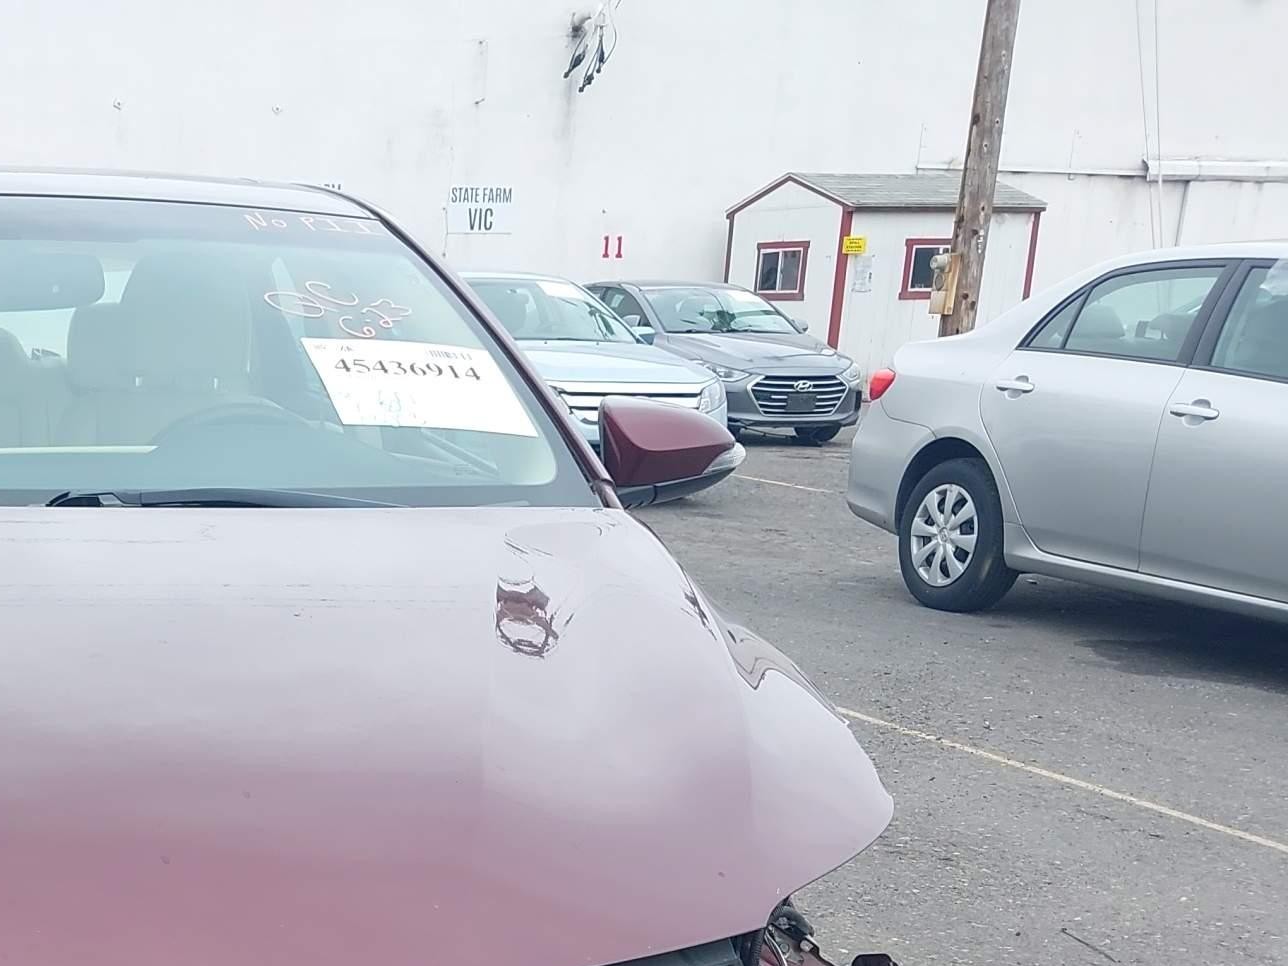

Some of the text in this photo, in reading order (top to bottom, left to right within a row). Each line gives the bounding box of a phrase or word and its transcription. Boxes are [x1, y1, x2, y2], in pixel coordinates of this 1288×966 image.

[451, 187, 512, 203] STATE FARM
[468, 207, 494, 231] VIC
[602, 235, 623, 259] 11
[334, 358, 482, 382] 45436914
